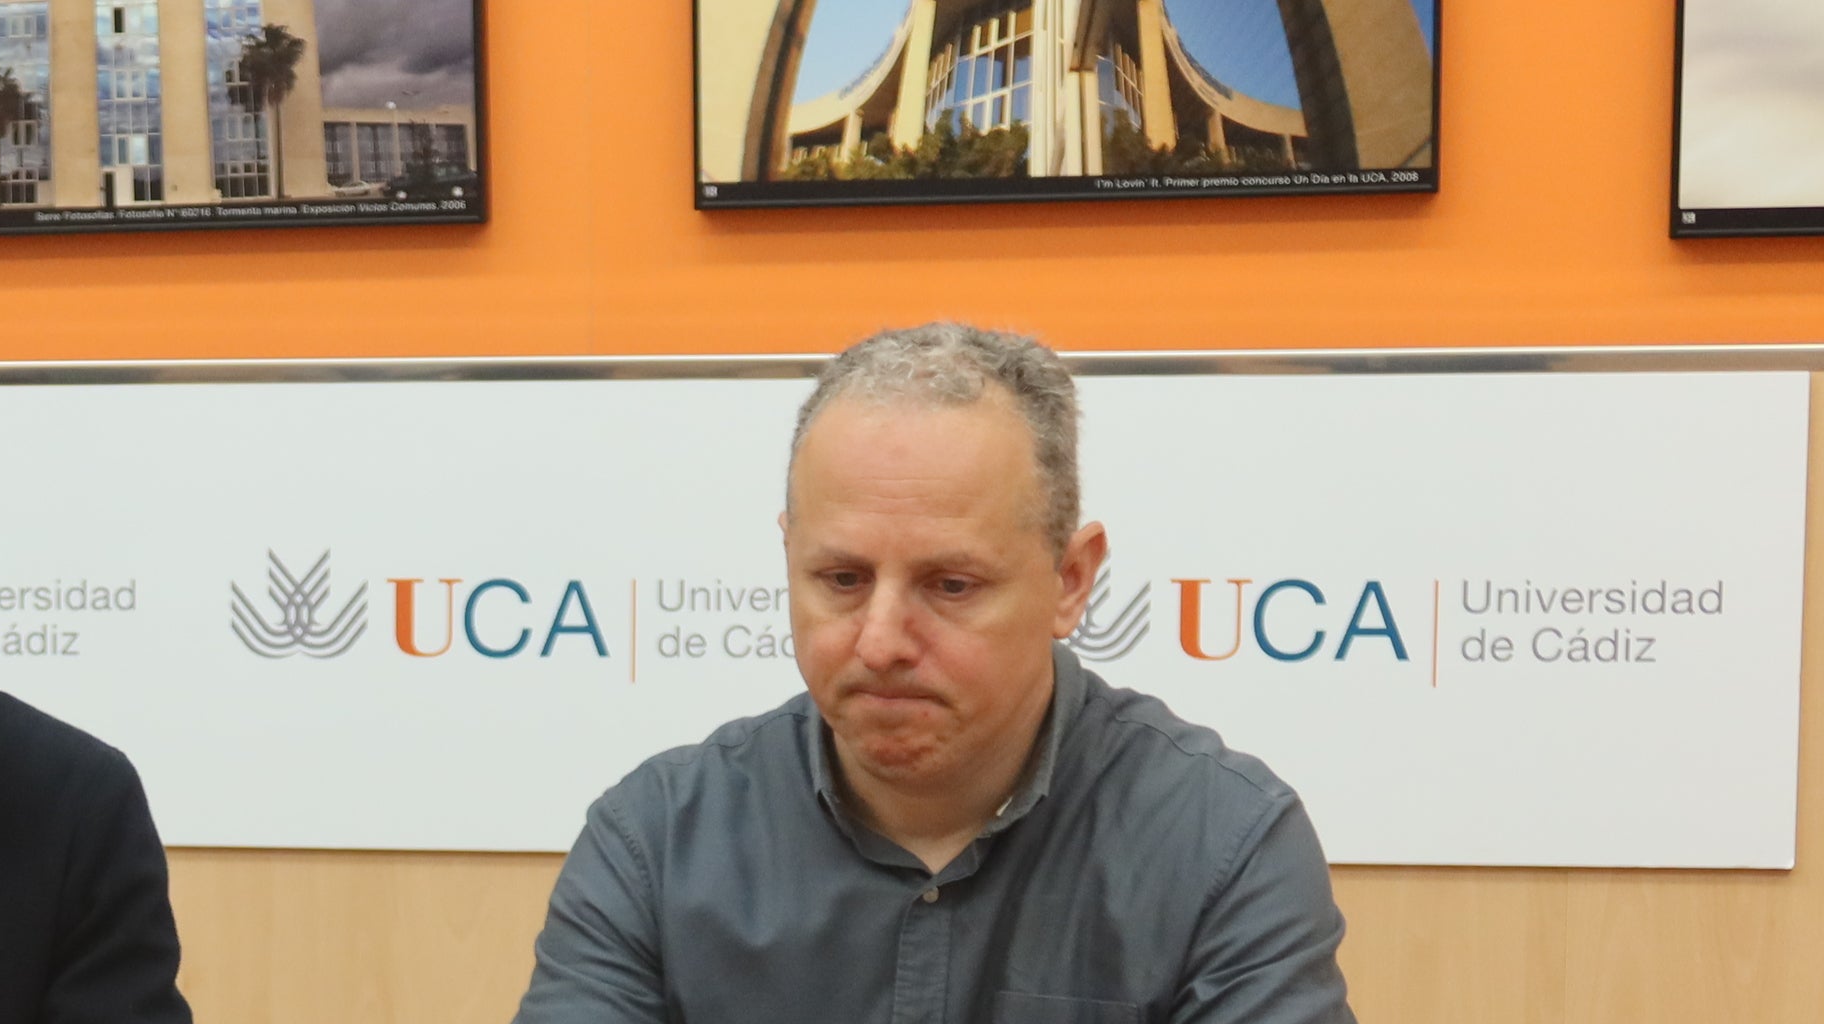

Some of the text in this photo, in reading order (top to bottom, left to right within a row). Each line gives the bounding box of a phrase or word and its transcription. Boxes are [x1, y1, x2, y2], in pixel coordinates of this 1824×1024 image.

[1166, 177, 1200, 188] Primer
[1203, 177, 1239, 188] premio
[658, 579, 789, 612] Univer
[1462, 579, 1724, 615] Universidad
[386, 578, 610, 658] UCA
[1170, 578, 1410, 662] UCA
[658, 625, 707, 658] de
[1461, 627, 1656, 663] de Cádiz
